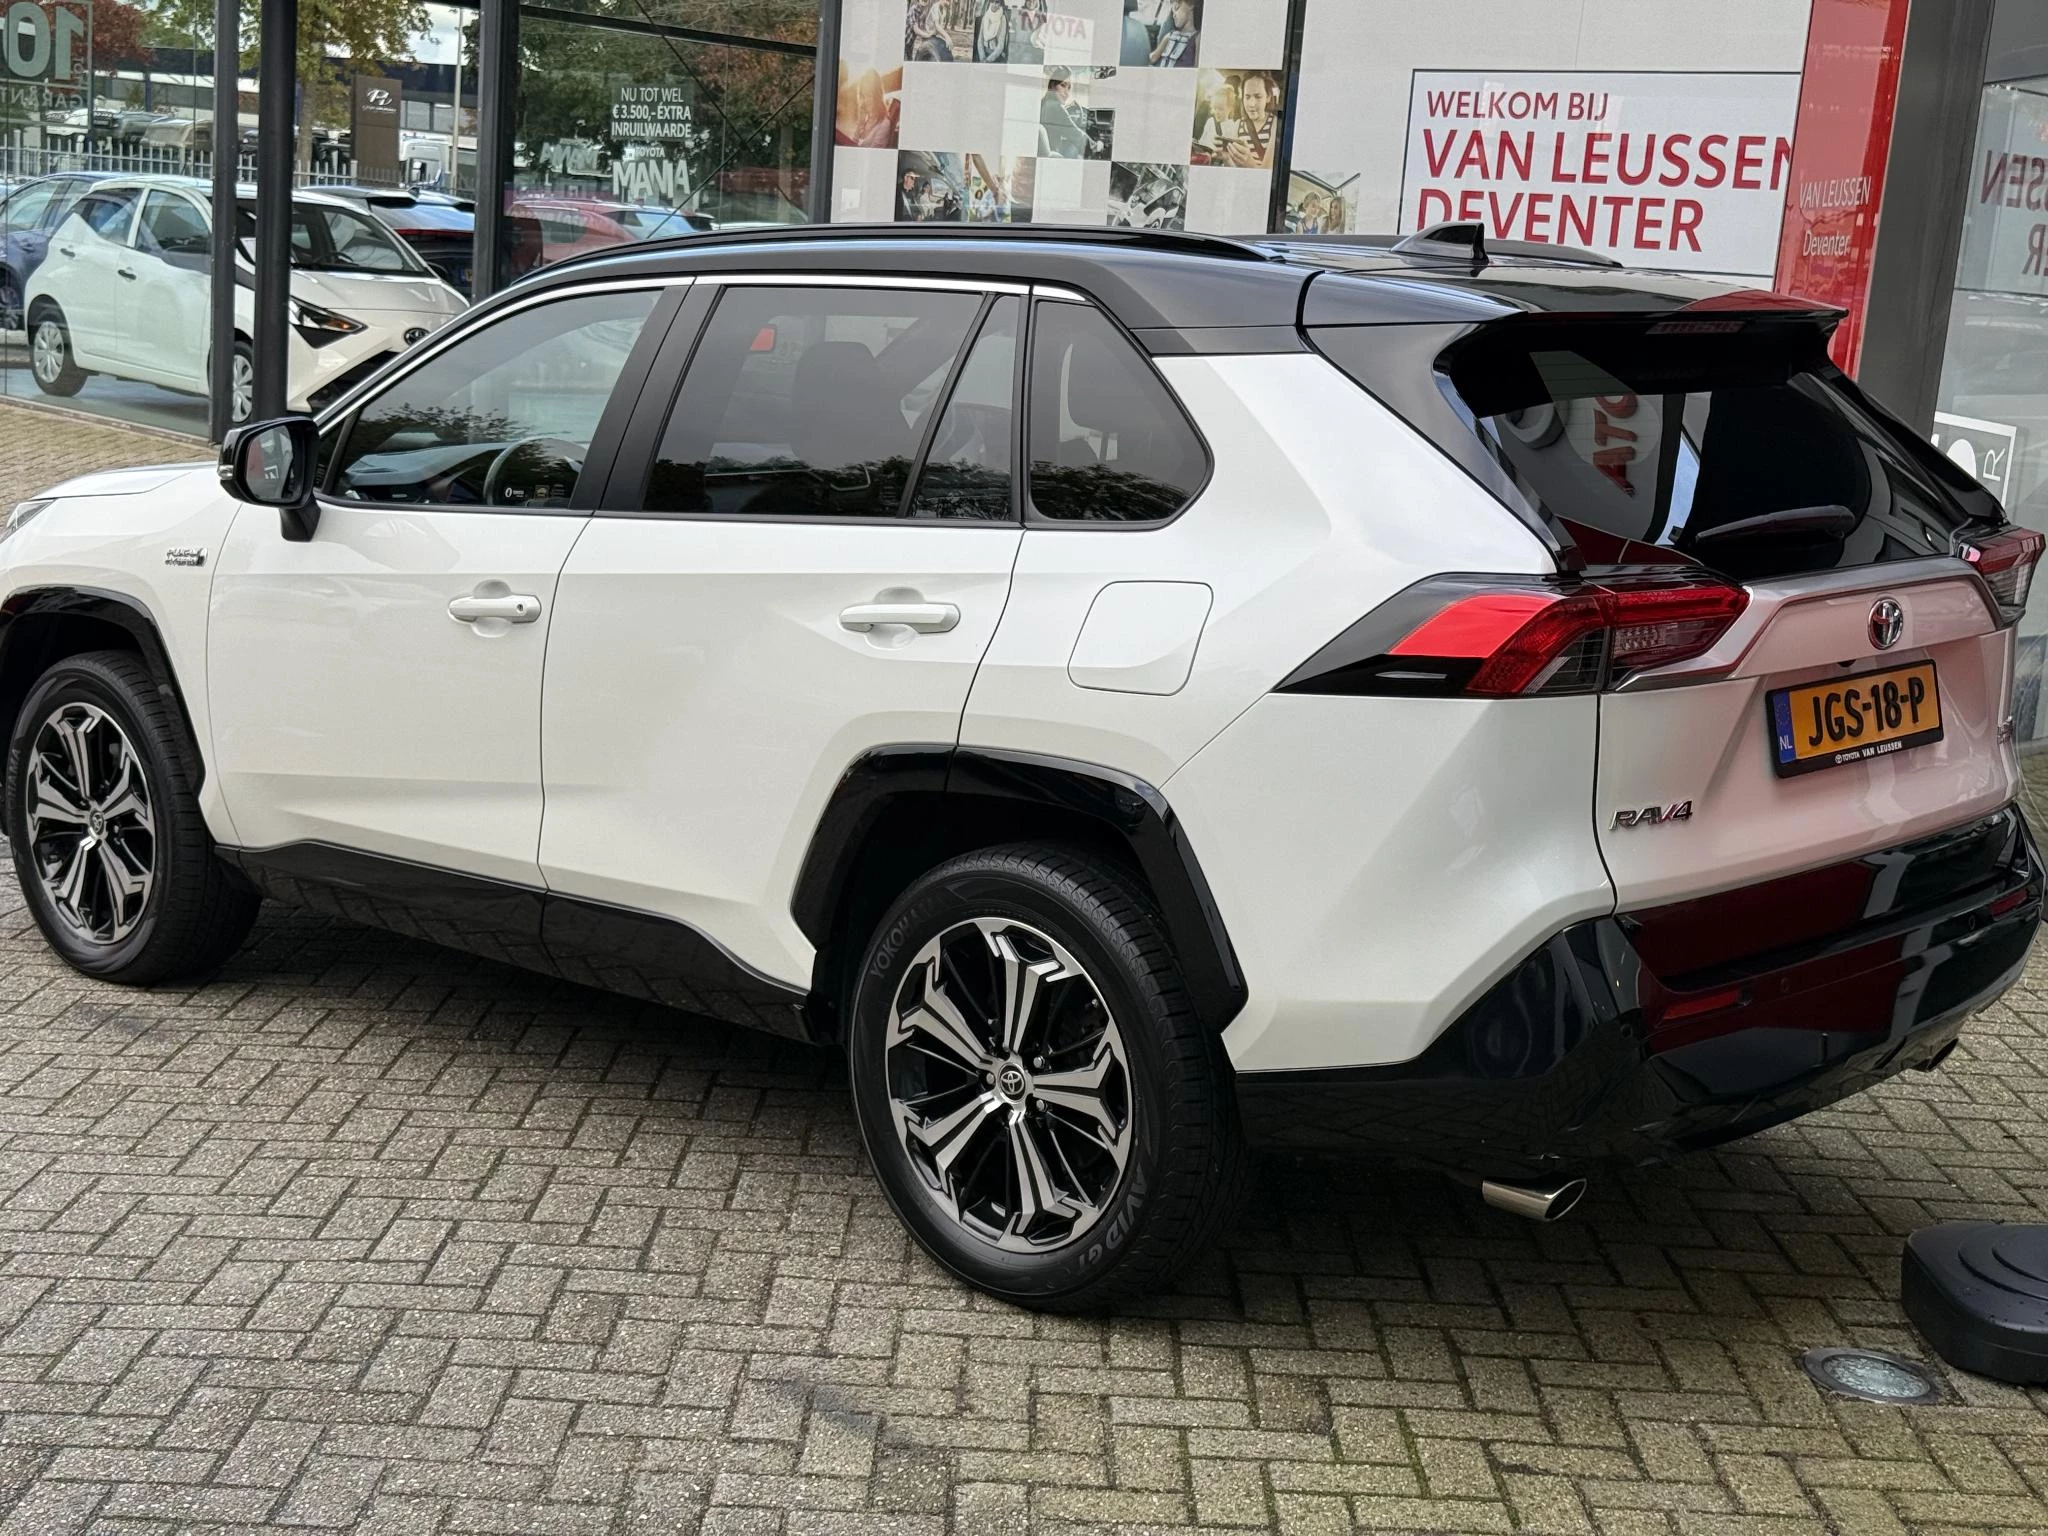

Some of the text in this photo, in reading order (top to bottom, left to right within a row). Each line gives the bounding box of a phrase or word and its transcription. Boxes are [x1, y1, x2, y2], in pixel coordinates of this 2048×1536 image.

[621, 88, 684, 102] NU TOT WEL
[1427, 91, 1609, 121] WELKOM BIJ
[657, 102, 691, 120] ÉXTRA
[611, 121, 692, 138] INRUILWAARDE
[635, 147, 665, 157] TOYOTA
[1423, 129, 1535, 181] VAN
[612, 159, 690, 199] MANIA
[1800, 176, 1872, 209] VAN LEUSSEN
[1417, 188, 1704, 252] DEVENTER
[1803, 230, 1850, 257] Deventer
[1809, 676, 1925, 746] JGS-18-P
[1779, 734, 1793, 750] NL
[1842, 741, 1903, 762] TOYOTA VAN LEUSSEN
[1609, 800, 1693, 830] RAV4
